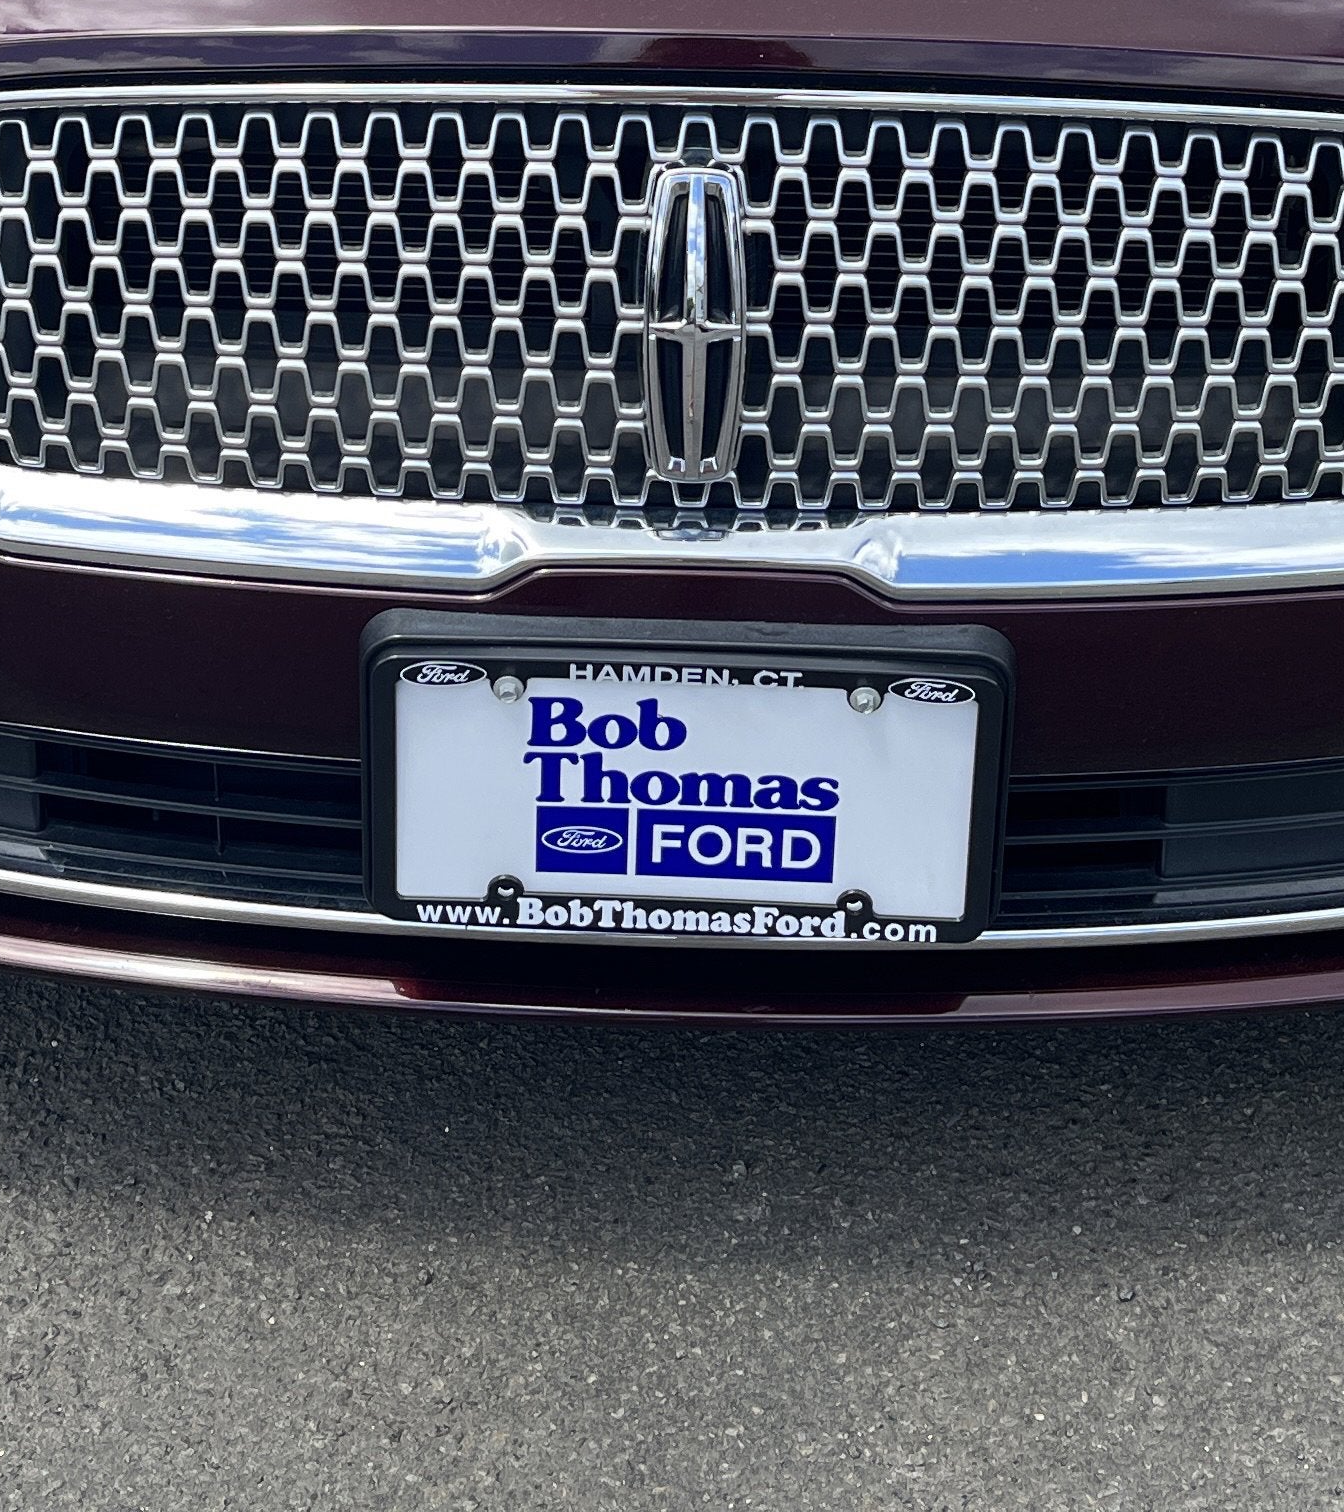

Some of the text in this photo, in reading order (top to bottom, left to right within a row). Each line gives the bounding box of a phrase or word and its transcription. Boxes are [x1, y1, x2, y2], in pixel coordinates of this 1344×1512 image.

[416, 664, 471, 685] Ford
[904, 680, 960, 703] Ford
[526, 696, 687, 751] Bob
[522, 751, 840, 812] Thomas
[556, 828, 608, 850] Ford
[651, 824, 822, 870] FORD
[416, 896, 937, 944] www.BobThomasFord.com
